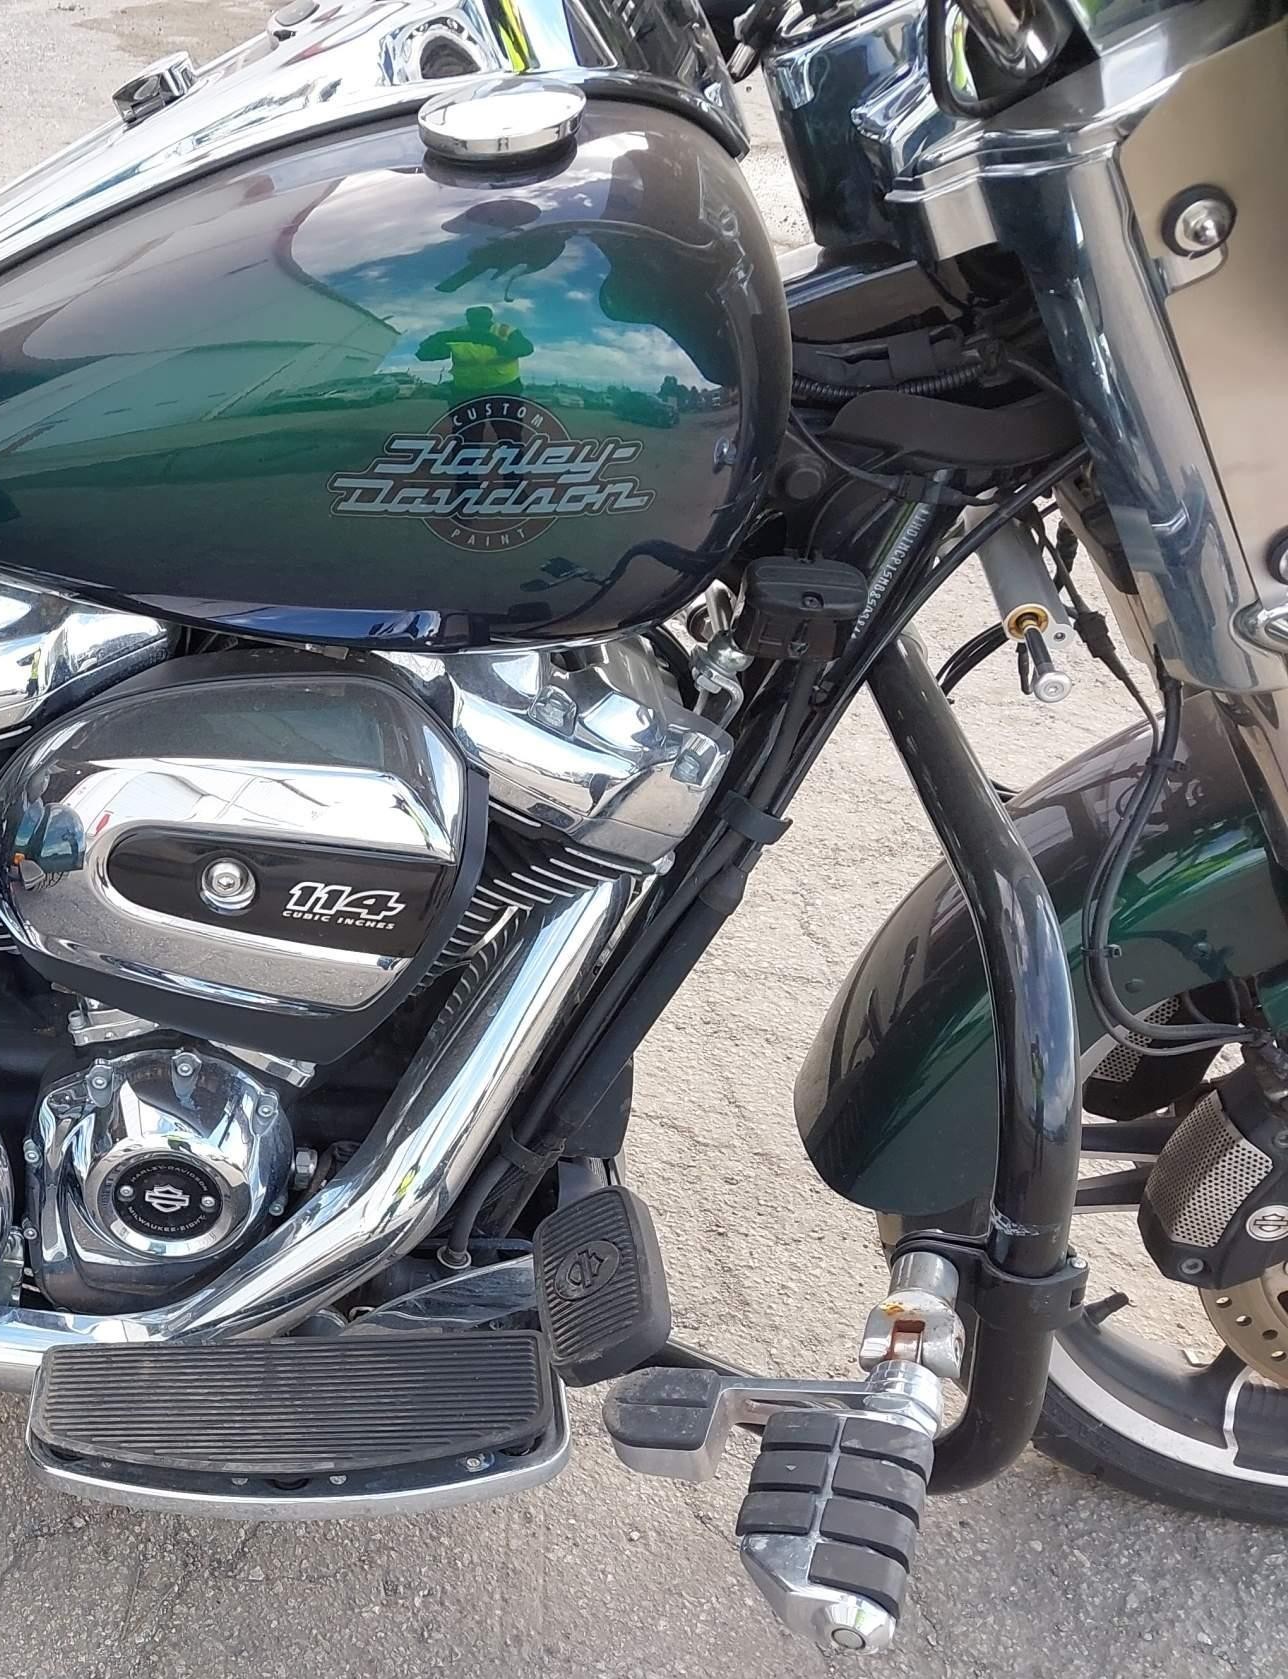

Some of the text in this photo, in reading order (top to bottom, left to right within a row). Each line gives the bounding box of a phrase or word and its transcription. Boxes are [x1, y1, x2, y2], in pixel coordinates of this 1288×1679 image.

[452, 402, 545, 428] CUSTOM
[373, 437, 637, 484] Harley
[333, 478, 650, 515] Davidson
[451, 526, 528, 547] PAINT
[285, 881, 406, 921] 114
[282, 910, 396, 930] CUBIC INCHES
[130, 1165, 209, 1192] HARLEY-DAVIDSON
